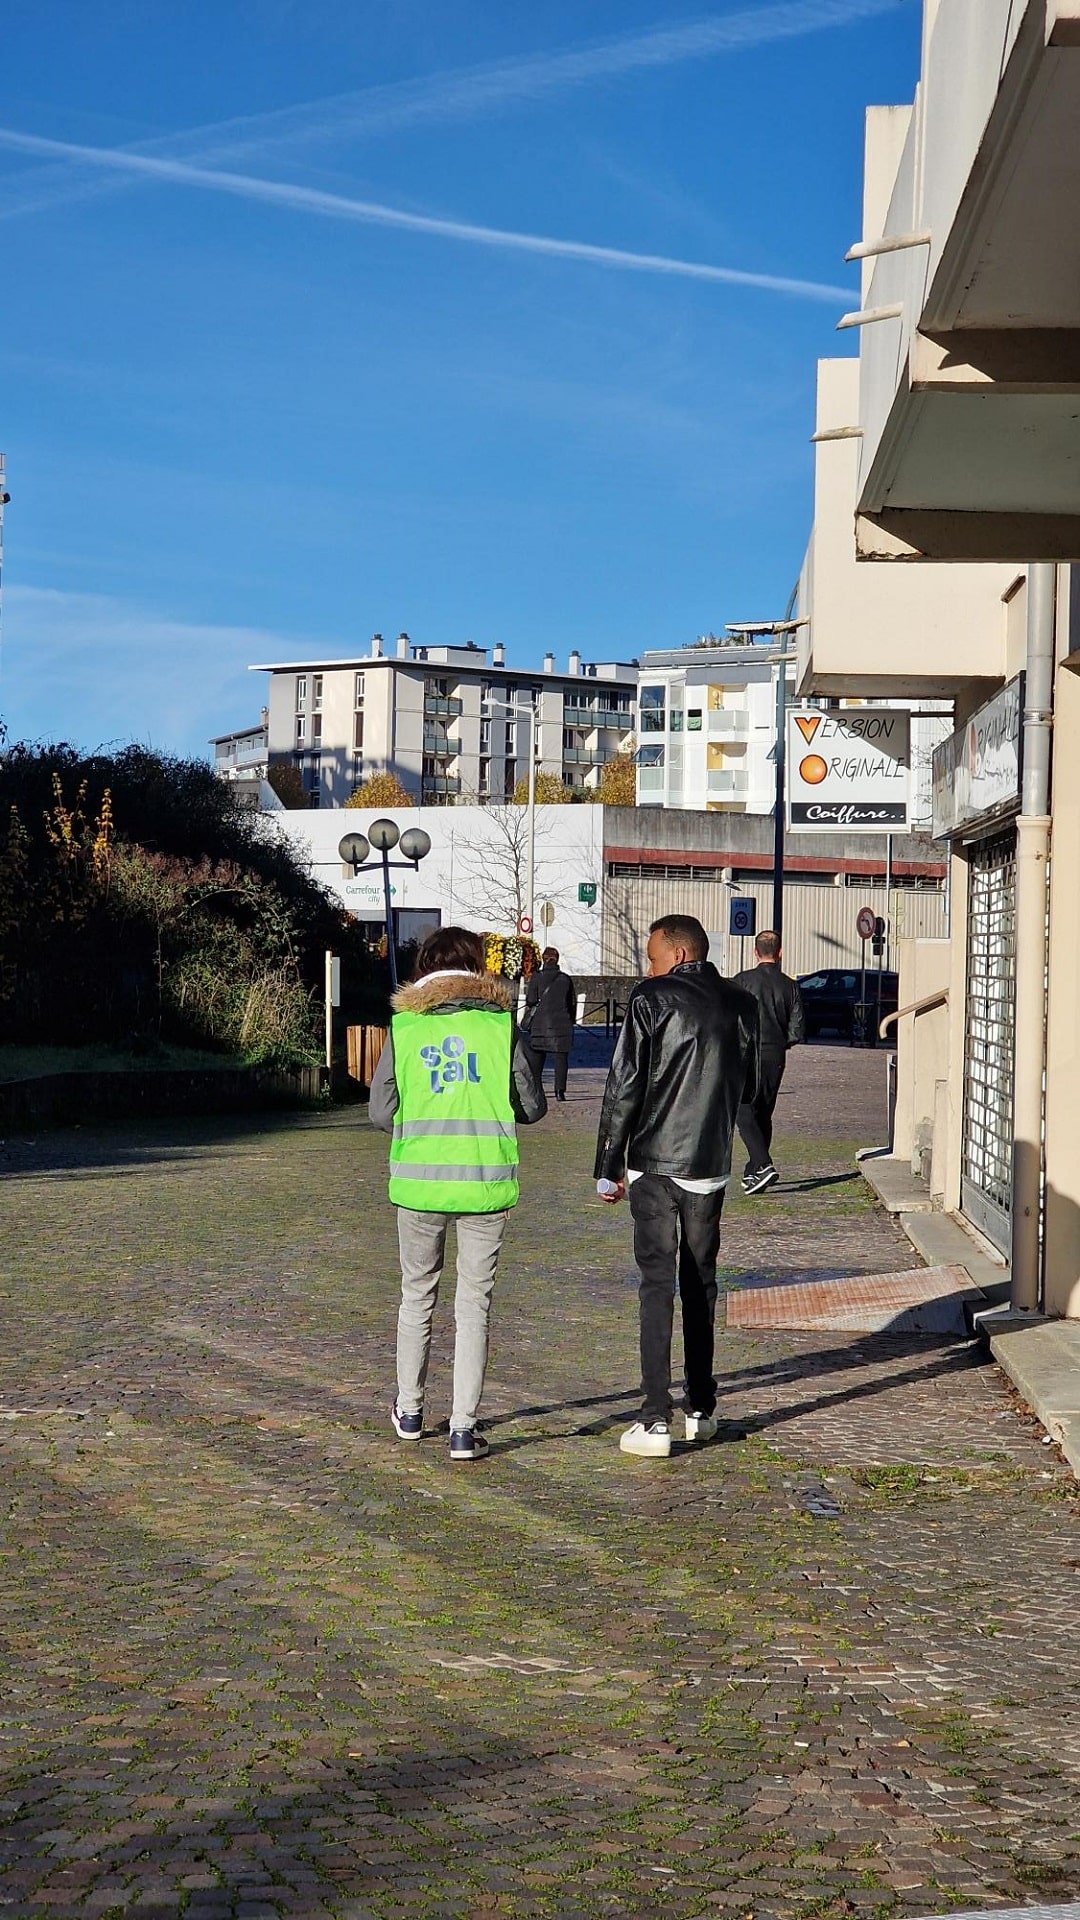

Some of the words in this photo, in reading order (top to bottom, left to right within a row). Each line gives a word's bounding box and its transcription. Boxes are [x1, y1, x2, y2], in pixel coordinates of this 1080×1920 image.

[793, 717, 895, 746] VERSION
[799, 754, 905, 785] ORIGINALE
[345, 885, 381, 895] Carrefour
[368, 895, 381, 906] city
